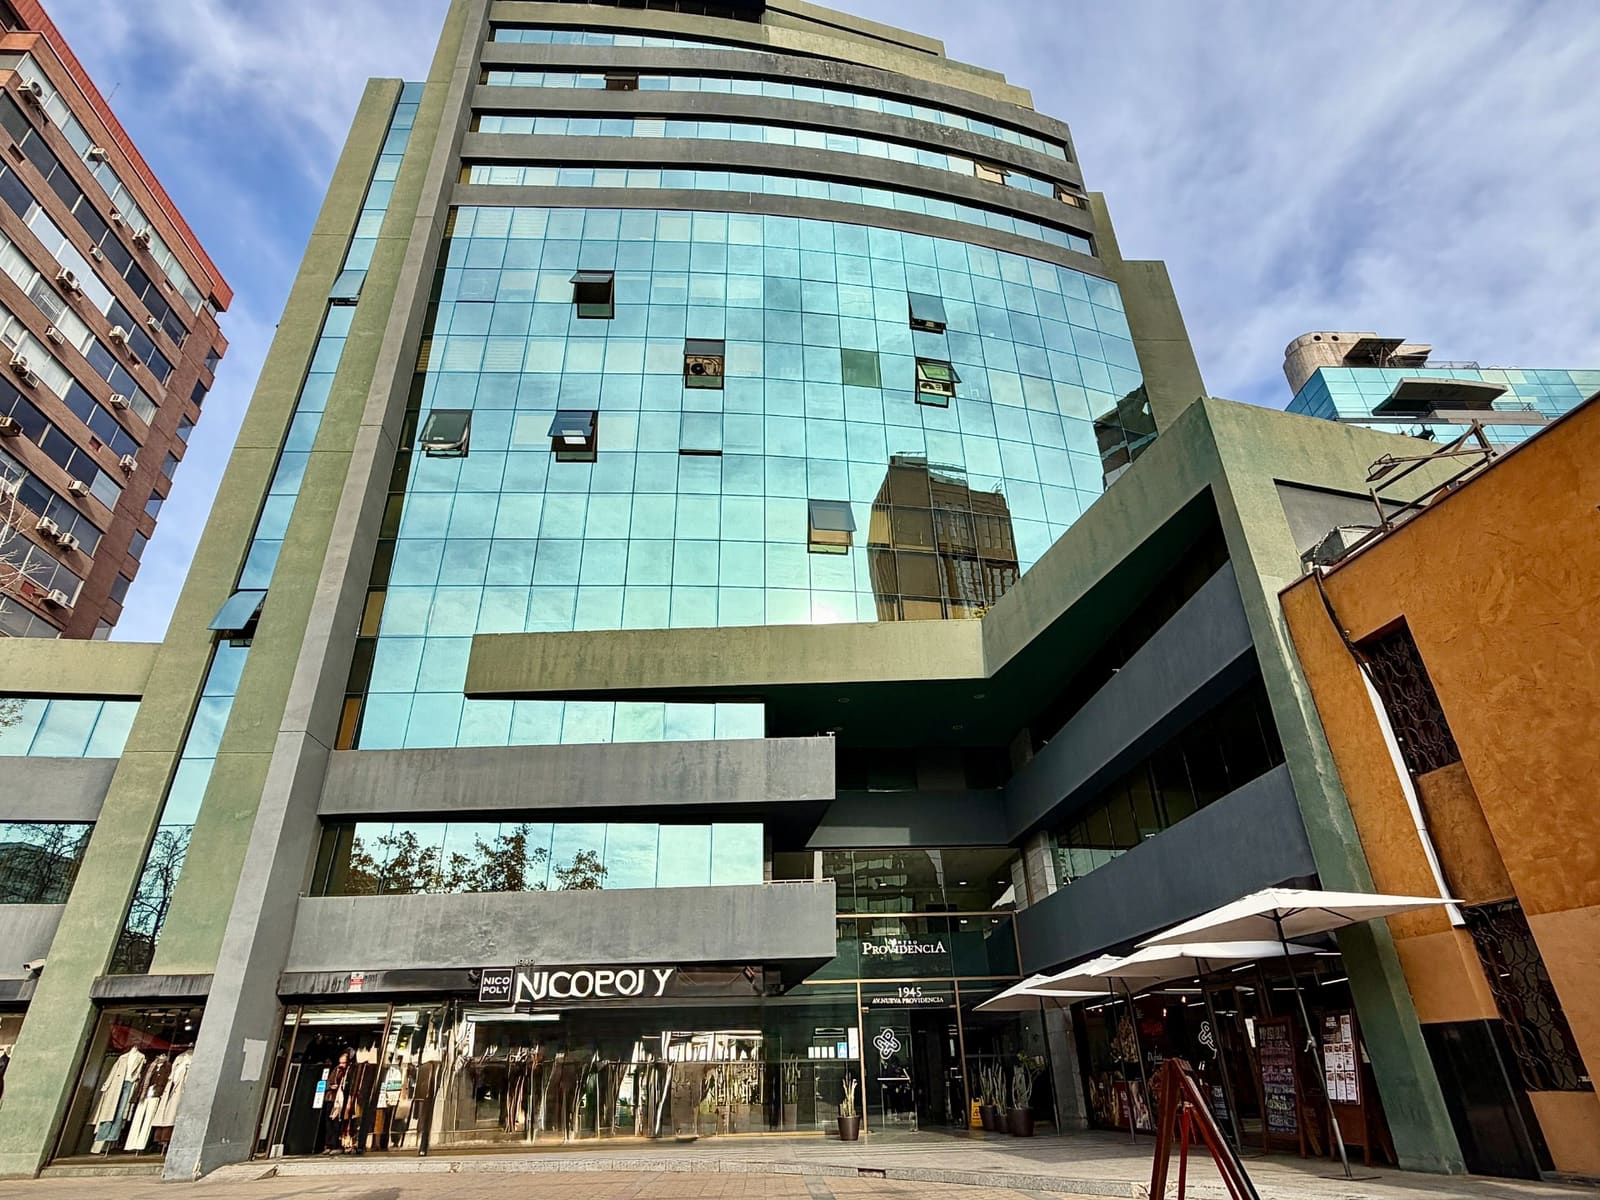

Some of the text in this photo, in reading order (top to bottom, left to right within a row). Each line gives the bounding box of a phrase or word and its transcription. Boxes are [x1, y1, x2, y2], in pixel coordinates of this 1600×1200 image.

[862, 941, 947, 955] PROVIDENCIA
[484, 976, 511, 985] NICO
[482, 985, 510, 995] POLY
[897, 987, 922, 998] 1945
